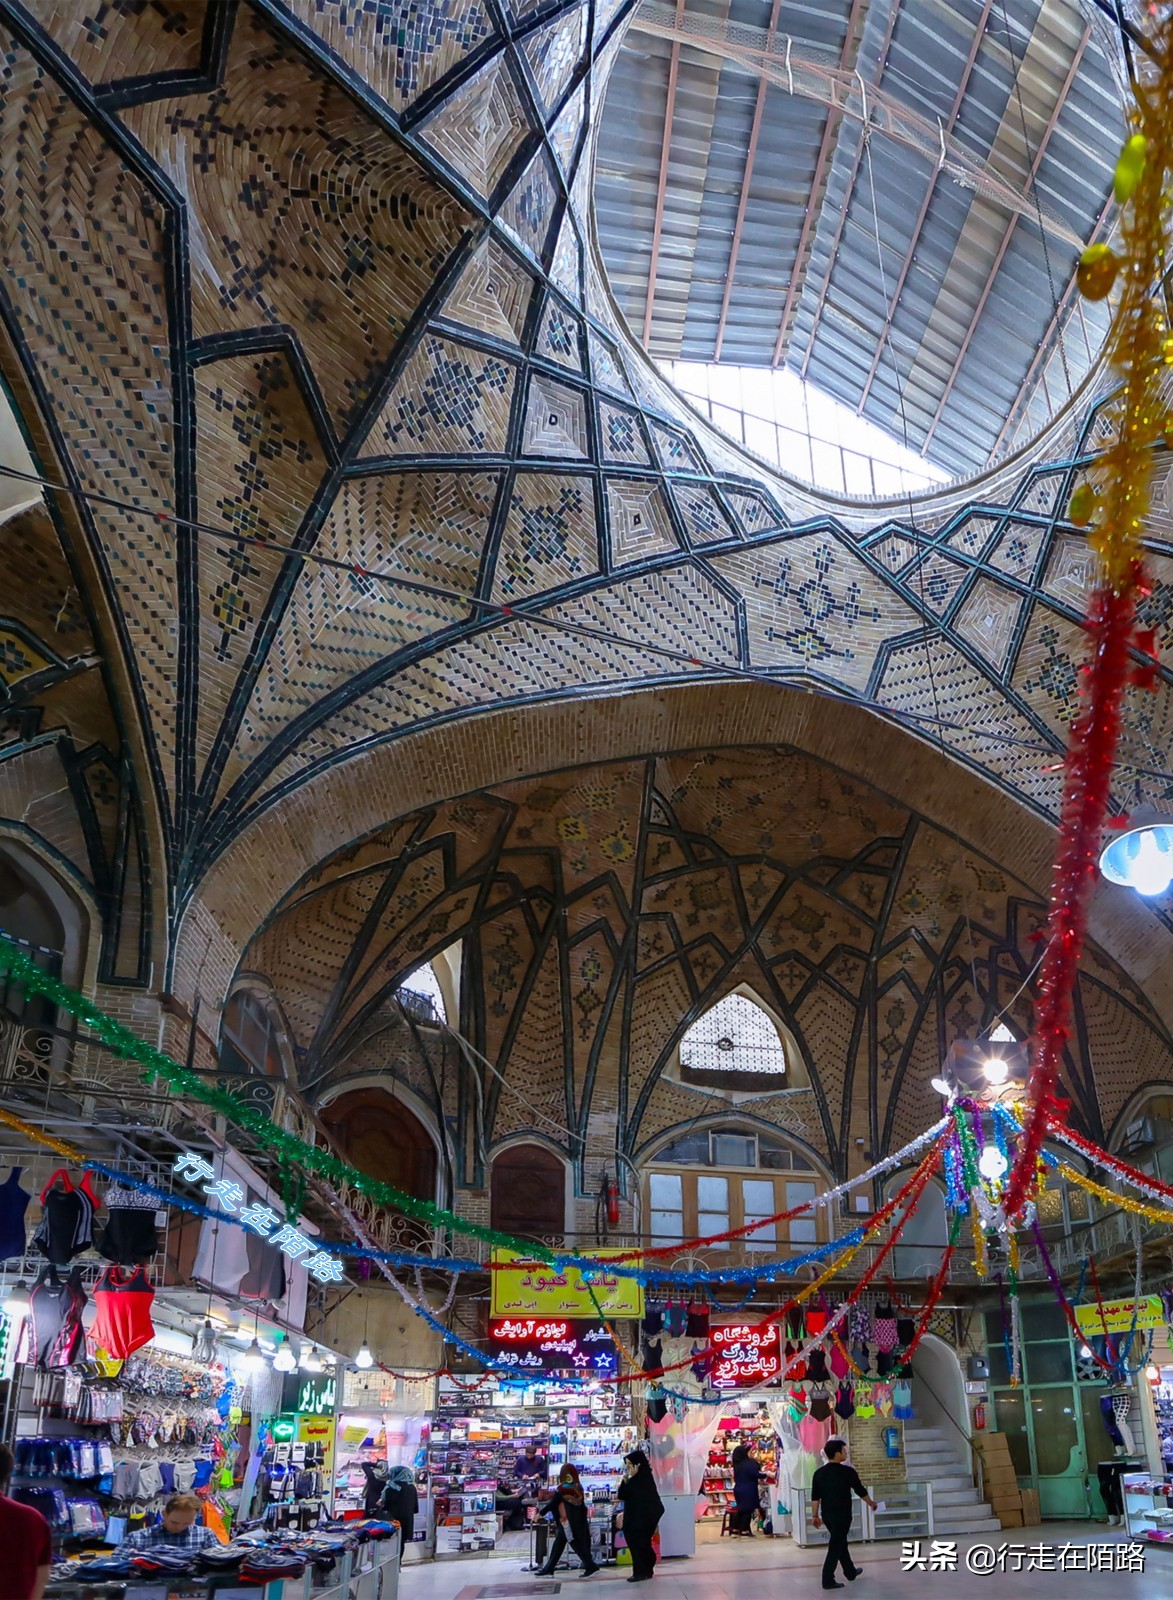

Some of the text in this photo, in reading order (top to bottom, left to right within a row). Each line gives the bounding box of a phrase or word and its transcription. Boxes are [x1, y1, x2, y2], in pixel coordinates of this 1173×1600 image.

[713, 1326, 777, 1346] فروشگاه
[722, 1343, 759, 1363] بزرگ
[740, 1357, 777, 1377] لباس
